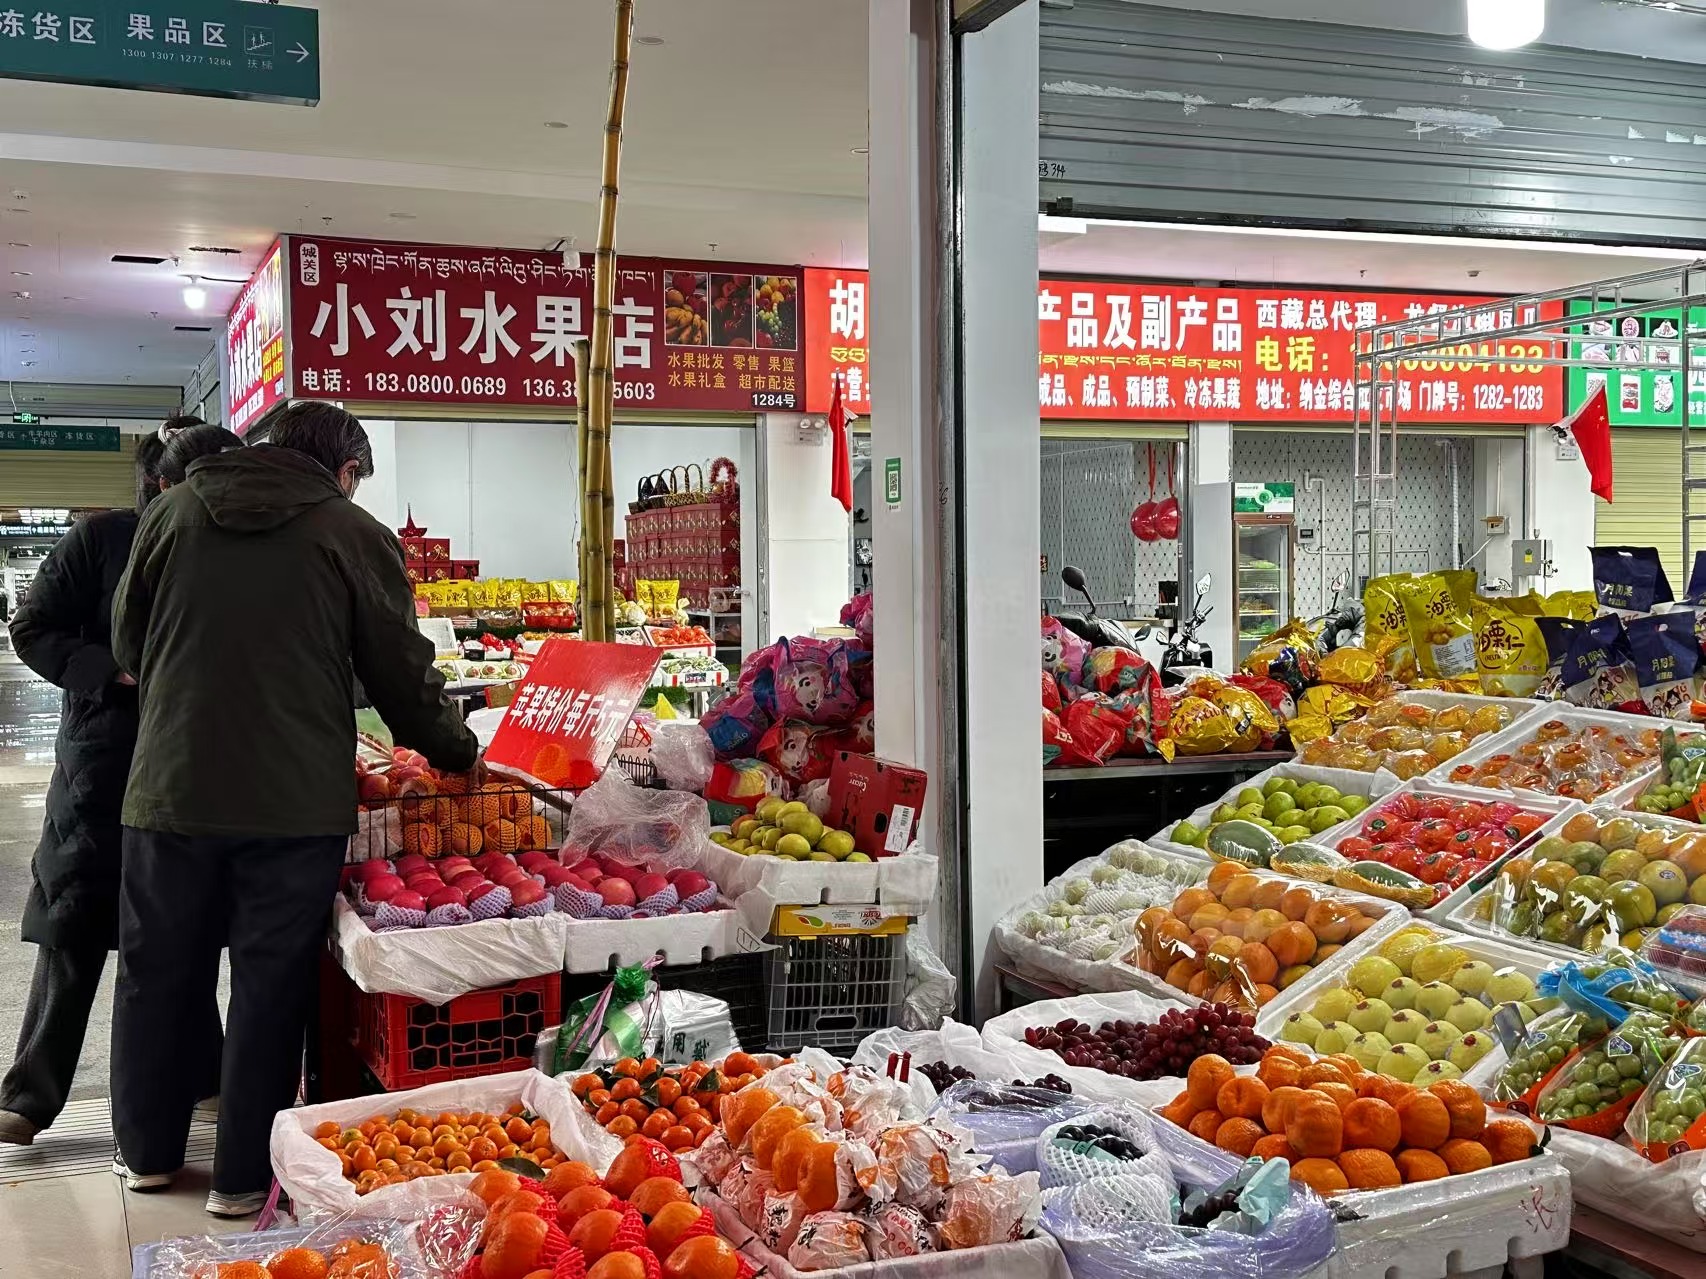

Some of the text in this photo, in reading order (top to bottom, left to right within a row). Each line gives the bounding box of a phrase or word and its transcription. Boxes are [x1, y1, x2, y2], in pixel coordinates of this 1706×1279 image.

[0, 9, 228, 48] 冻货区 果品区
[121, 48, 147, 59] 1300
[150, 51, 175, 62] 1307
[208, 57, 232, 67] 1284
[302, 244, 320, 284] 城关区
[310, 282, 654, 369] 小刘水果店
[829, 279, 1242, 352] 胡 产品及副产品
[667, 352, 796, 374] 水果批发 零售 果篮
[1255, 335, 1329, 373] 电话：
[302, 367, 351, 394] 电话：
[364, 372, 507, 396] 183.0800.0689
[667, 371, 796, 392] 水果礼盒 超市配送
[752, 394, 796, 409] 1284号
